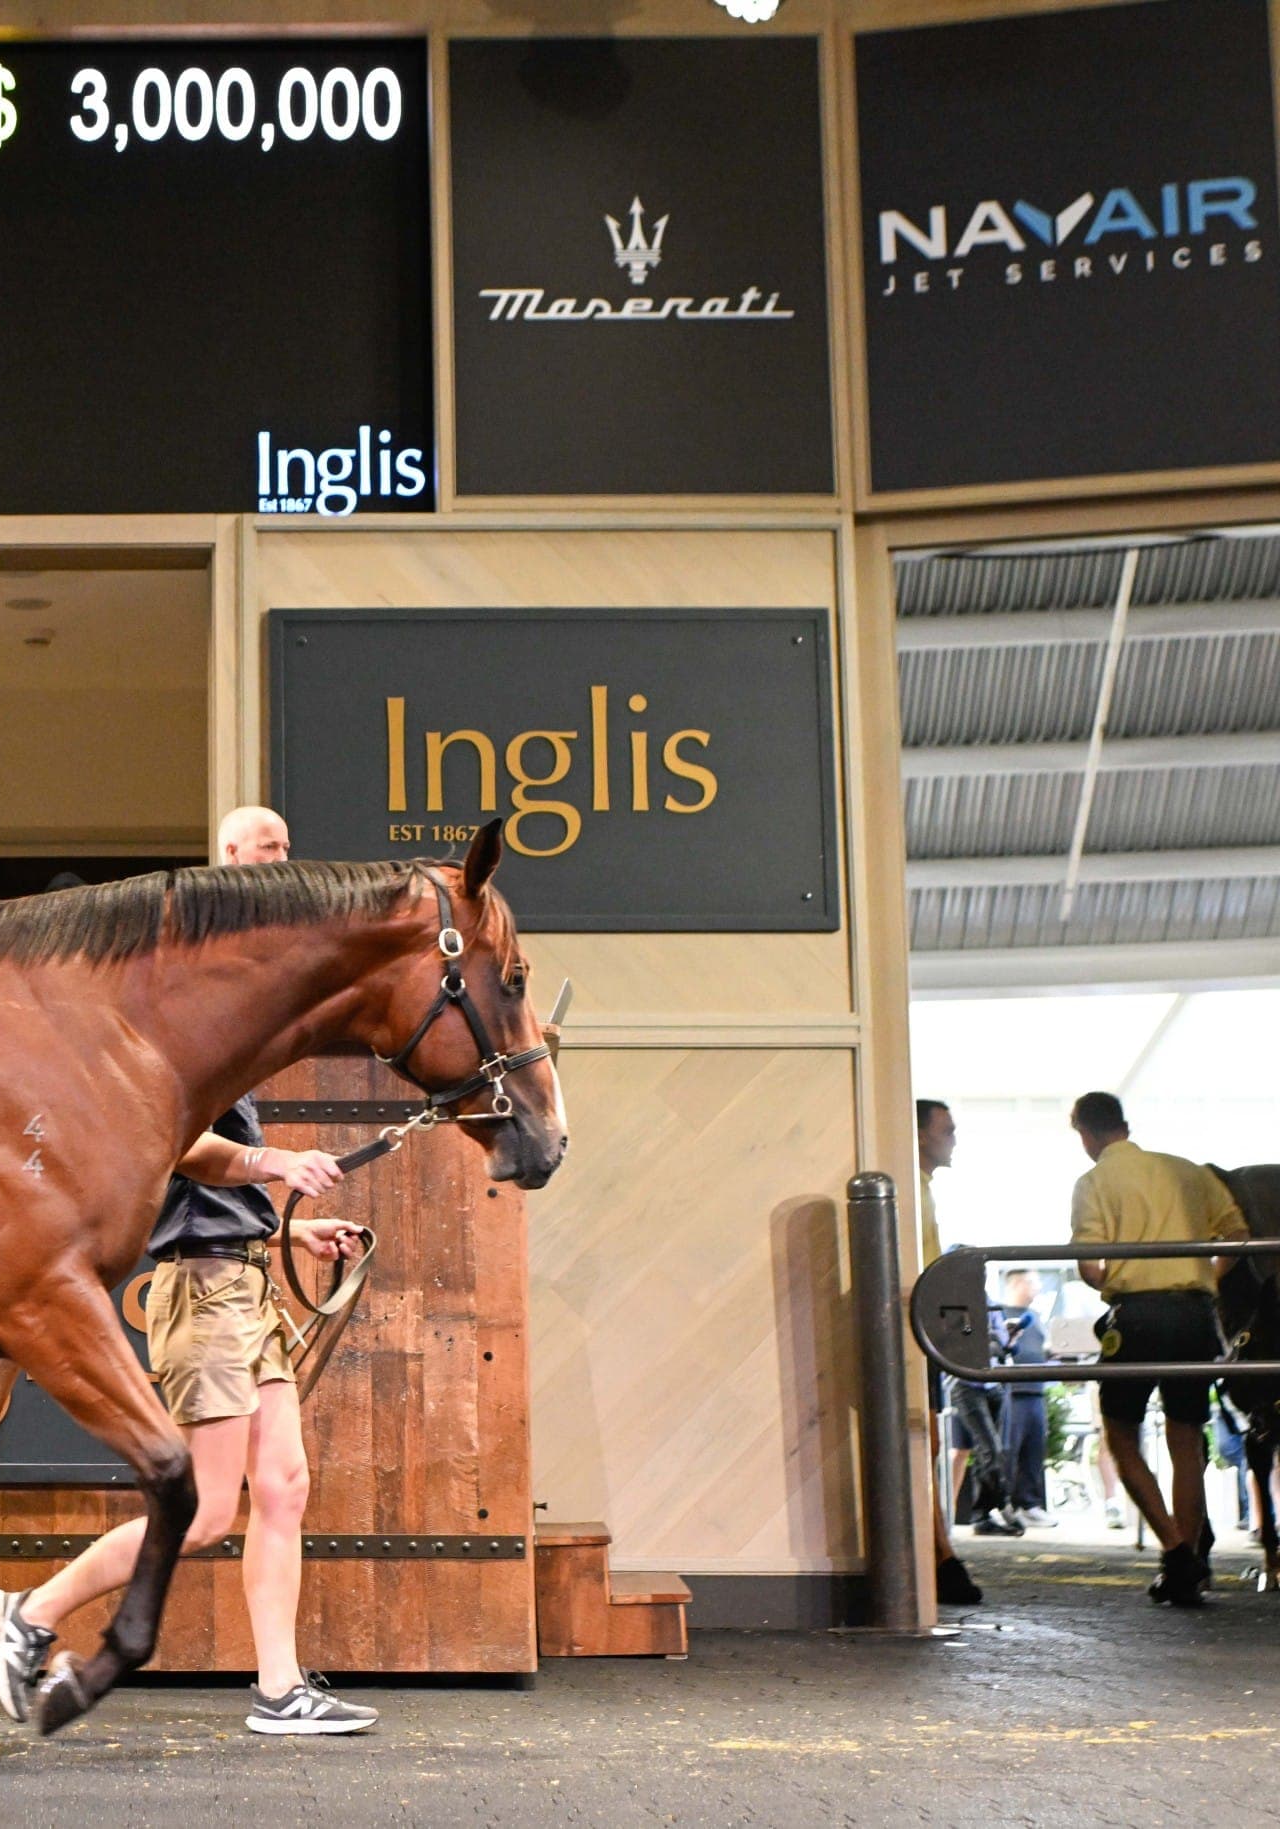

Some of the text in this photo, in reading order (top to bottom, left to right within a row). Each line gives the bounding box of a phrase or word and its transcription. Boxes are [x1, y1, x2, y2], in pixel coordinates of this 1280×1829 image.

[69, 67, 402, 152] 3,000,000
[879, 176, 1259, 264] NAVAIR
[882, 240, 1263, 296] JET SERVICES
[480, 286, 795, 321] Maserati
[257, 425, 426, 517] Inglis
[257, 498, 313, 513] Est 1867
[387, 685, 719, 857] Inglis
[389, 825, 480, 841] EST 1867
[23, 1113, 45, 1142] 4
[22, 1149, 45, 1178] 4
